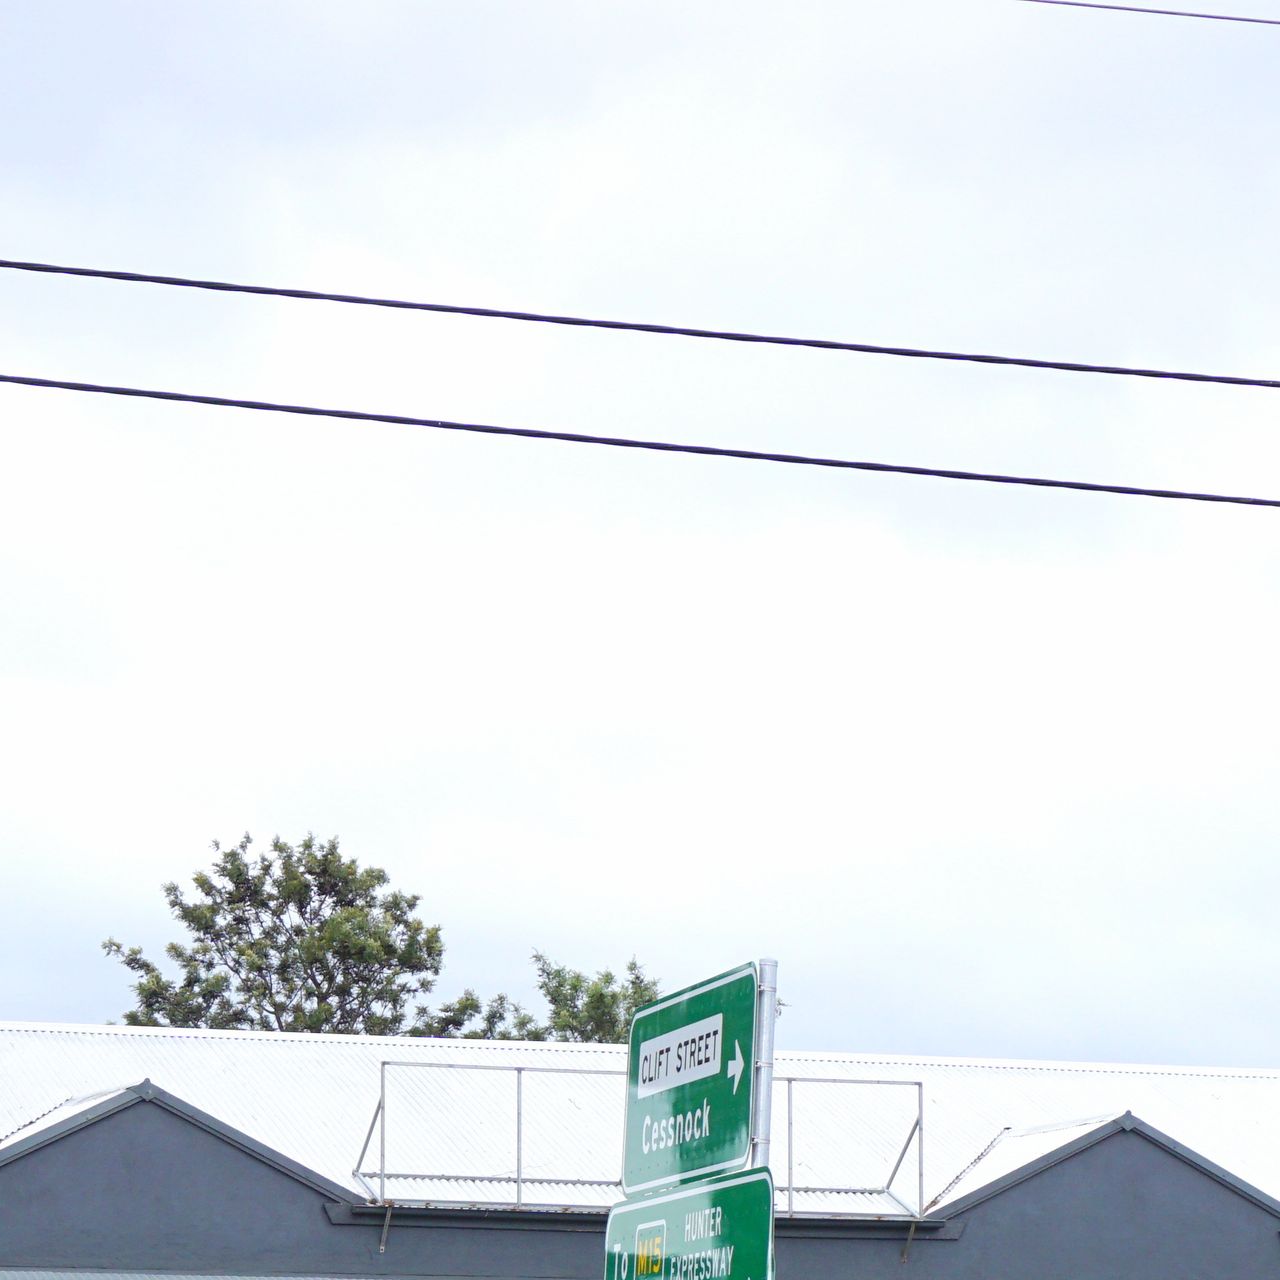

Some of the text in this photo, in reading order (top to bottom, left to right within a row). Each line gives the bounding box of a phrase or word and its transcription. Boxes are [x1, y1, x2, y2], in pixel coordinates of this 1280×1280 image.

[641, 1030, 719, 1085] CLIFT STREET
[642, 1097, 711, 1155] Cessnock
[684, 1206, 722, 1242] HUNTER
[637, 1237, 662, 1276] M15
